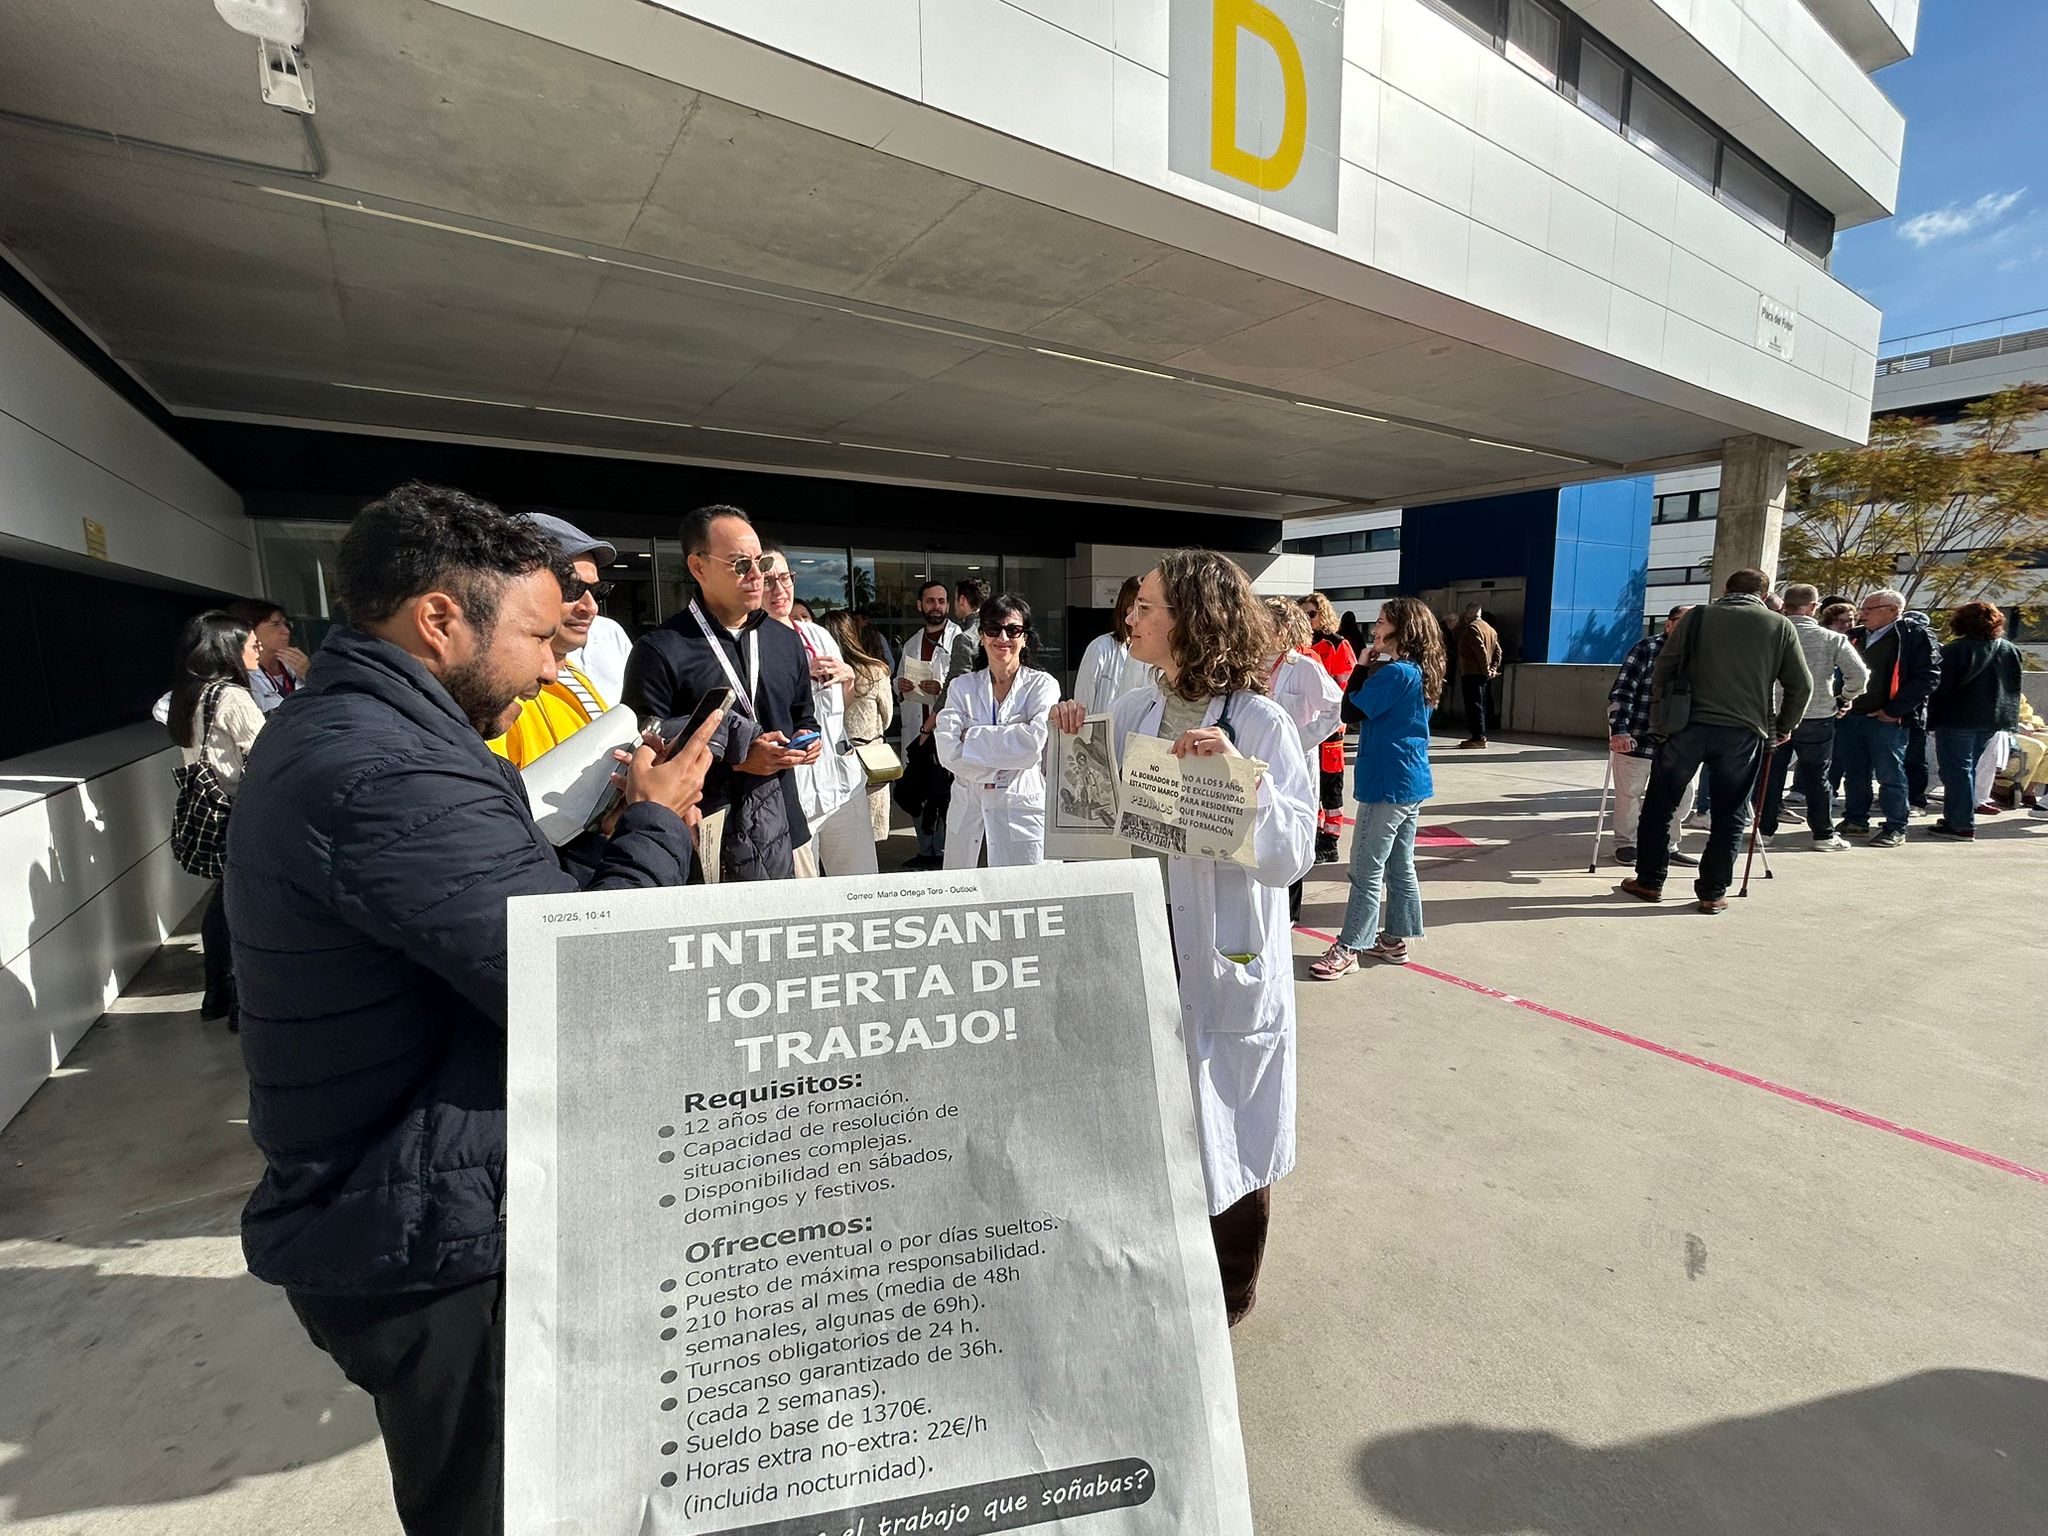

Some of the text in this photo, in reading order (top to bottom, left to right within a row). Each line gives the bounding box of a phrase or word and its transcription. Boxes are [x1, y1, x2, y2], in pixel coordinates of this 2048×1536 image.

[1211, 0, 1308, 192] D
[1130, 780, 1179, 798] ESTATUTO MARCO
[1131, 770, 1179, 788] AL BORRADOR DE
[1150, 764, 1160, 772] NO
[1183, 774, 1193, 782] NO
[1196, 776, 1201, 784] A
[1203, 777, 1217, 786] LOS
[1225, 781, 1244, 792] AÑOS
[1131, 795, 1173, 815] PEDIMOS
[1180, 796, 1244, 816] PARA RESIDENTES
[1180, 806, 1234, 825] QUE FINALICEN
[1193, 787, 1245, 804] EXCLUSIVIDAD
[1178, 818, 1233, 837] SU FORMACIÓN
[543, 911, 610, 923] 10/2/25, 10:41
[847, 892, 874, 900] Correo:
[900, 889, 925, 897] Ortega
[669, 905, 1065, 971] INTERESANTE
[708, 956, 1040, 1022] ¡OFERTA DE
[735, 1008, 1017, 1072] TRABAJO!
[685, 1074, 862, 1113] Requisitos:
[685, 1090, 908, 1136] 12 años de formación.
[684, 1104, 958, 1157] Capacidad de resolución de
[684, 1134, 911, 1180] situaciones complejas.
[685, 1148, 952, 1202] Disponibilidad en sábados,
[685, 1179, 894, 1224] domingos y festivos.
[685, 1218, 1058, 1287] Contrato eventual o por días sueltos.
[686, 1217, 872, 1263] Ofrecemos:
[686, 1266, 1019, 1333] 210 horas al mes (media de 48h
[687, 1239, 1045, 1311] Puesto de máxima responsabilidad.
[685, 1318, 979, 1378] Turnos obligatorios de 24 h.
[686, 1294, 985, 1356] semanales, algunas de 69h).
[688, 1339, 1002, 1404] Descanso garantizado de 36h.
[687, 1379, 885, 1431] (cada 2 semanas).
[687, 1398, 931, 1453] Sueldo base de 1370€.
[687, 1415, 986, 1482] Horas extra no-extra: 22€/h
[684, 1456, 933, 1520] (incluida nocturnidad).
[878, 1503, 969, 1535] trabajo
[984, 1496, 1027, 1521] que
[1042, 1469, 1148, 1505] soñabas?
